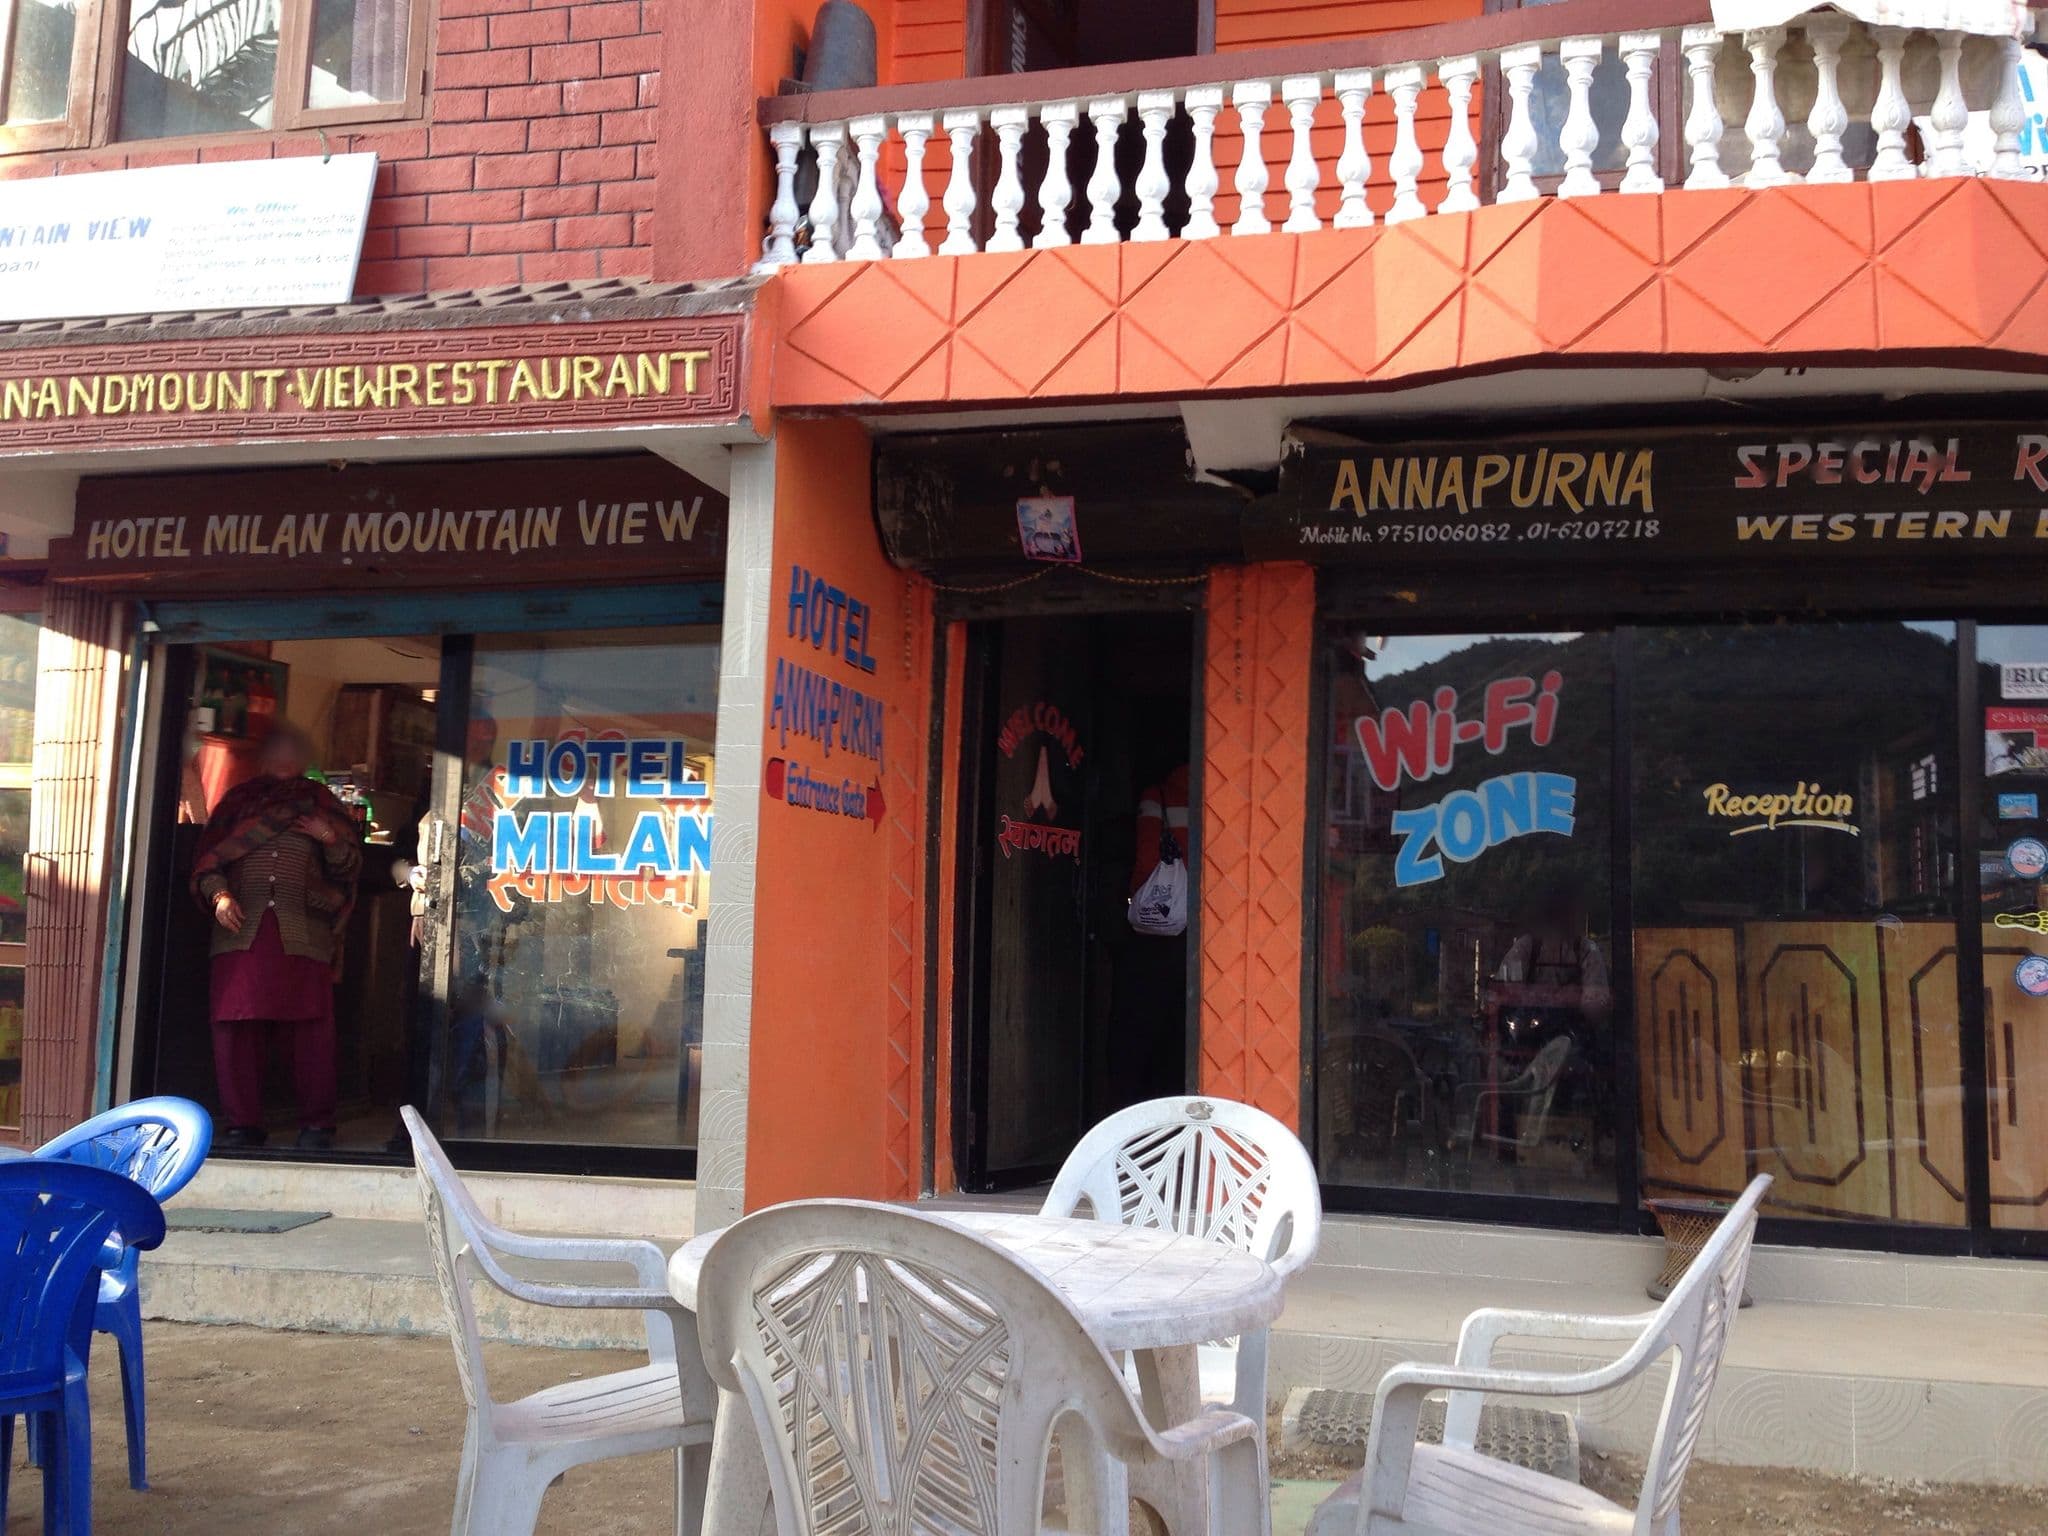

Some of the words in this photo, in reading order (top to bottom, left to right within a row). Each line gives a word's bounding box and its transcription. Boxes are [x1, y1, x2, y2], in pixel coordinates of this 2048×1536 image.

[88, 216, 152, 240] VIEW
[389, 351, 711, 407] RESTAURANT
[1329, 447, 1655, 519] ANNAPURNA
[1734, 438, 1971, 496] SPECIAL
[87, 517, 191, 560] HOTEL
[203, 513, 329, 559] MILAN
[341, 507, 562, 555] MOUNTAIN
[578, 497, 704, 546] VIEW
[1299, 525, 1349, 545] Mobile
[1377, 522, 1511, 544] 9751006082
[1736, 509, 2012, 542] WESTERN
[787, 564, 878, 676] HOTEL
[770, 656, 885, 776] ANNAPURNA
[1355, 670, 1564, 792] Wi-Fi
[506, 739, 709, 798] HOTEL
[1391, 771, 1577, 888] ZONE
[1702, 780, 1853, 830] Reception
[491, 811, 714, 875] MILAN
